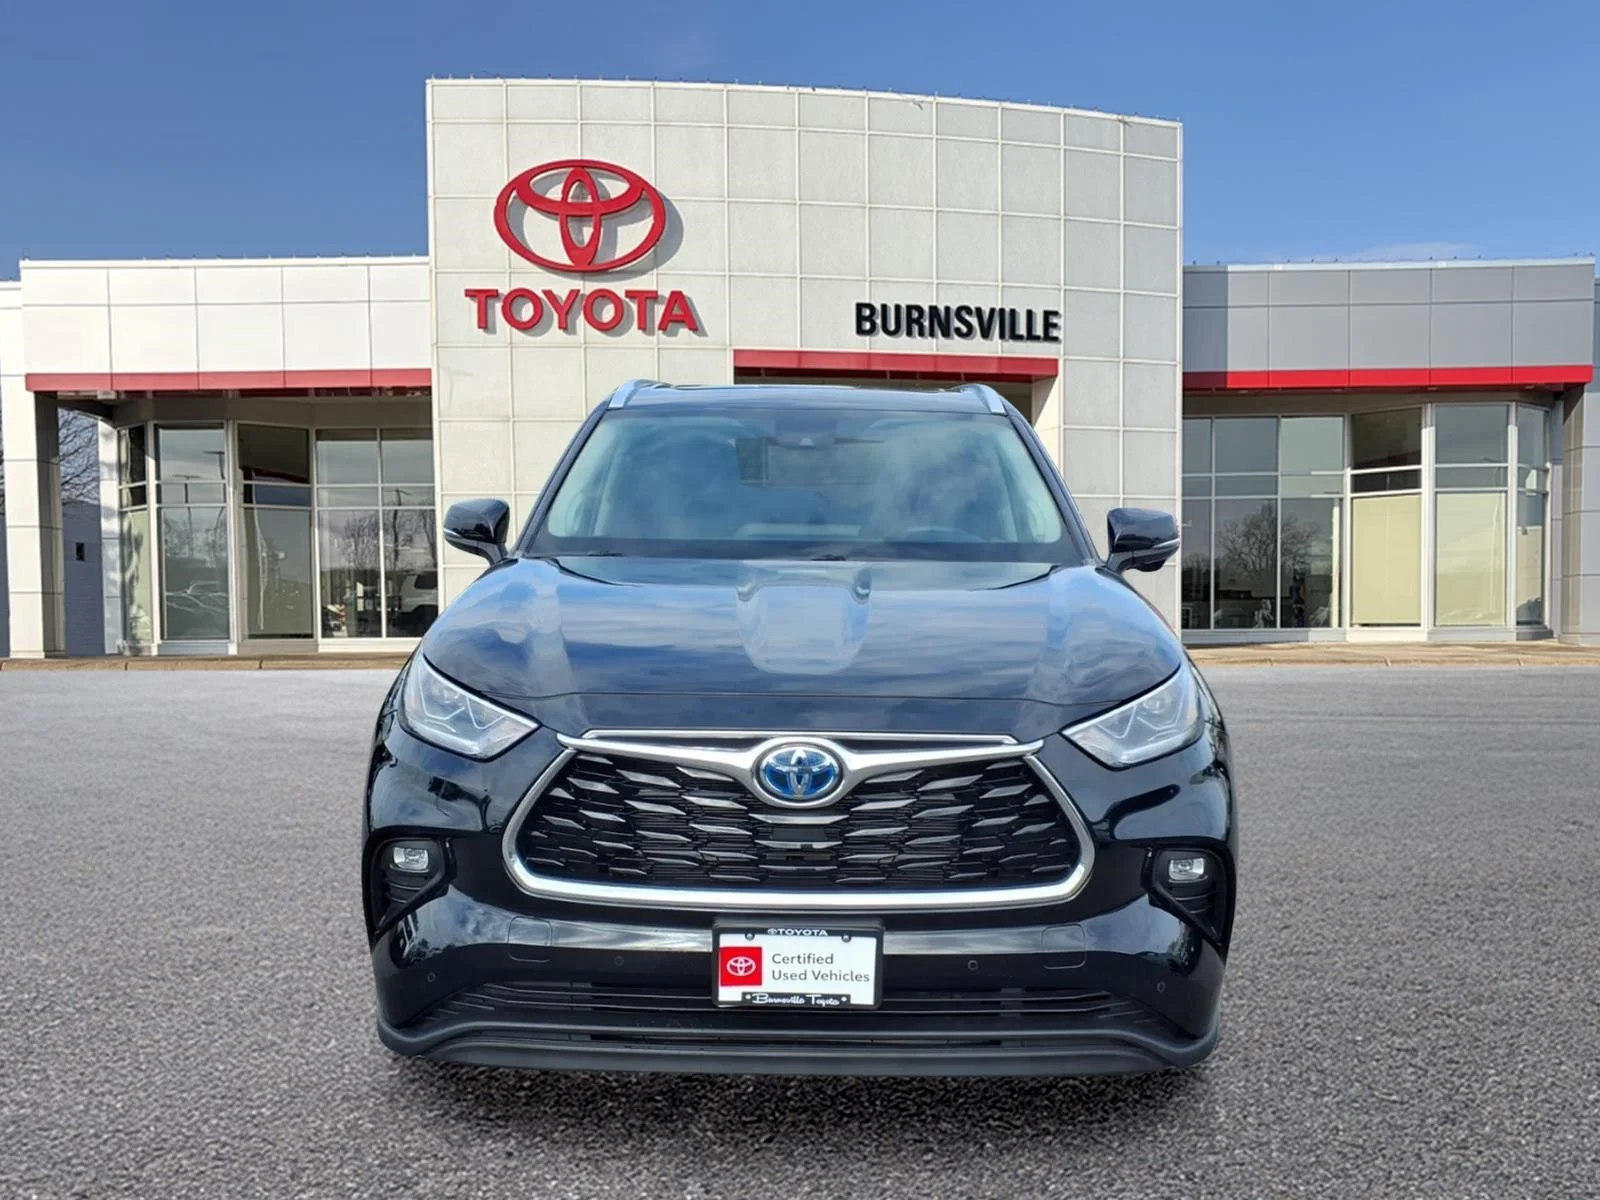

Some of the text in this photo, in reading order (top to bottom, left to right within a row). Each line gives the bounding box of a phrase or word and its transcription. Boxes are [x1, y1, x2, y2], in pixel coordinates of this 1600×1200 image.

[464, 288, 699, 332] TOYOTA
[855, 302, 1061, 342] BURNSVILLE
[777, 928, 829, 936] TOYOTA
[771, 953, 834, 965] Certified
[772, 969, 870, 982] Used Vehicles
